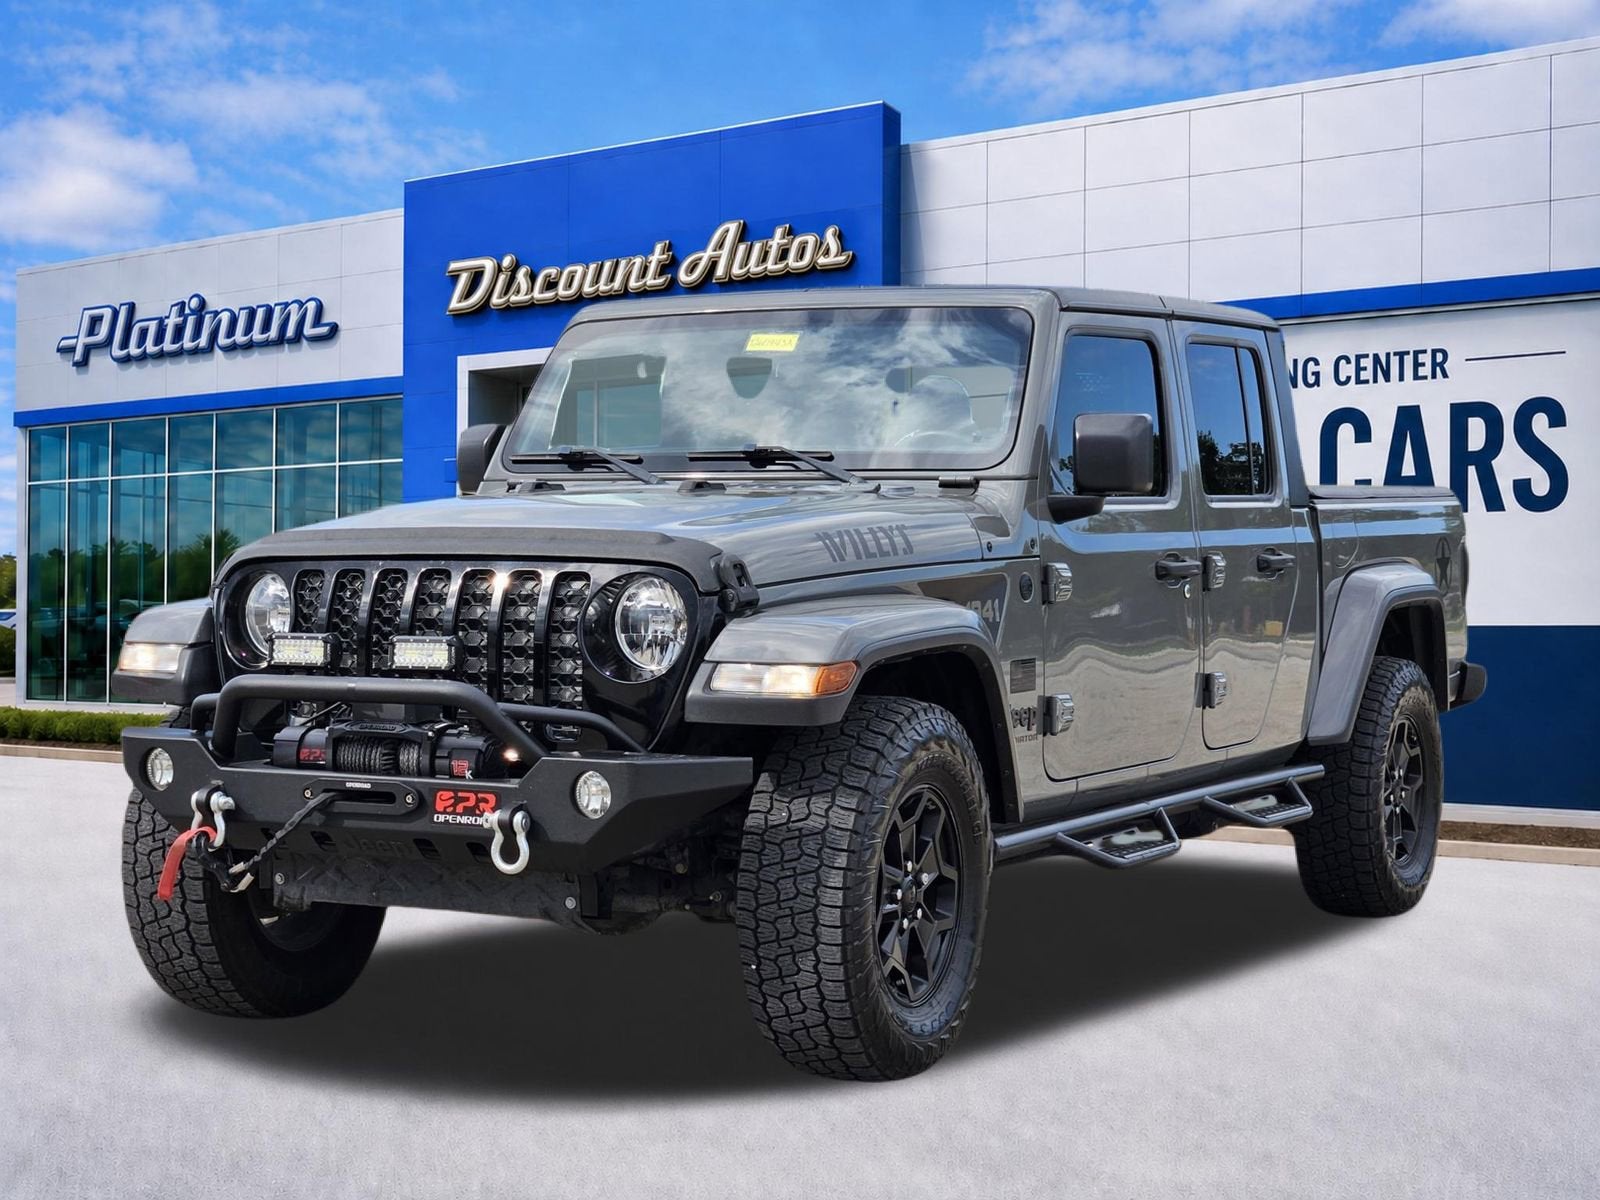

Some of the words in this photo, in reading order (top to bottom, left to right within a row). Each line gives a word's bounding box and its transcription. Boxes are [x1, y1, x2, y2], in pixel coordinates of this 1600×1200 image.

[446, 239, 673, 315] Discount
[677, 219, 853, 288] Autos
[56, 293, 339, 367] Platinum
[1333, 348, 1450, 387] CENTER
[1319, 396, 1569, 513] CARS
[814, 524, 914, 563] WILLYS
